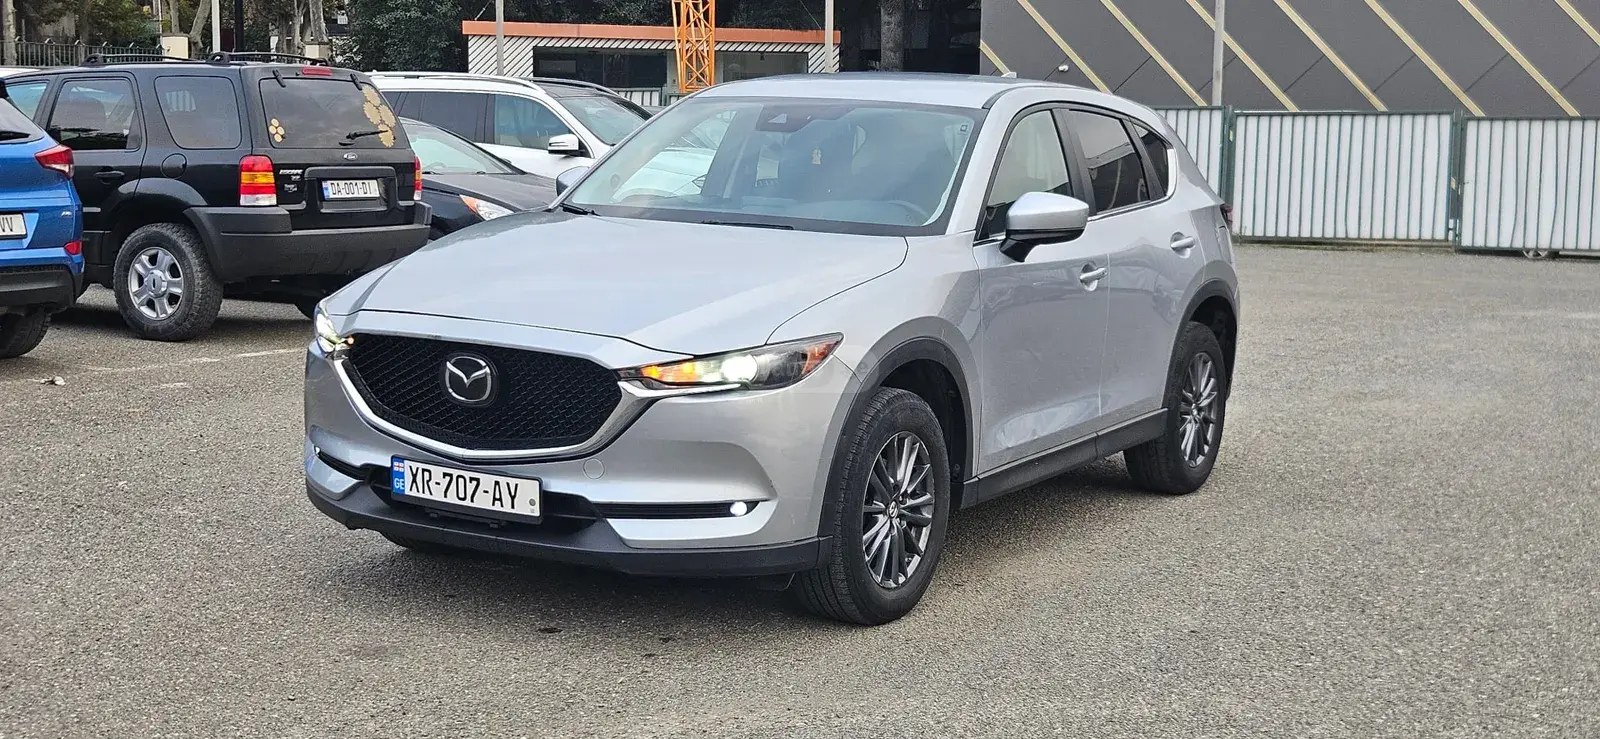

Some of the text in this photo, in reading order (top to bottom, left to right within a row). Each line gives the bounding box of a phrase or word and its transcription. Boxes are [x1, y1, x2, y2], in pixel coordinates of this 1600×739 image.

[330, 181, 372, 196] DA-001-DI
[394, 477, 405, 490] GE
[409, 465, 519, 509] XR-707-AY
